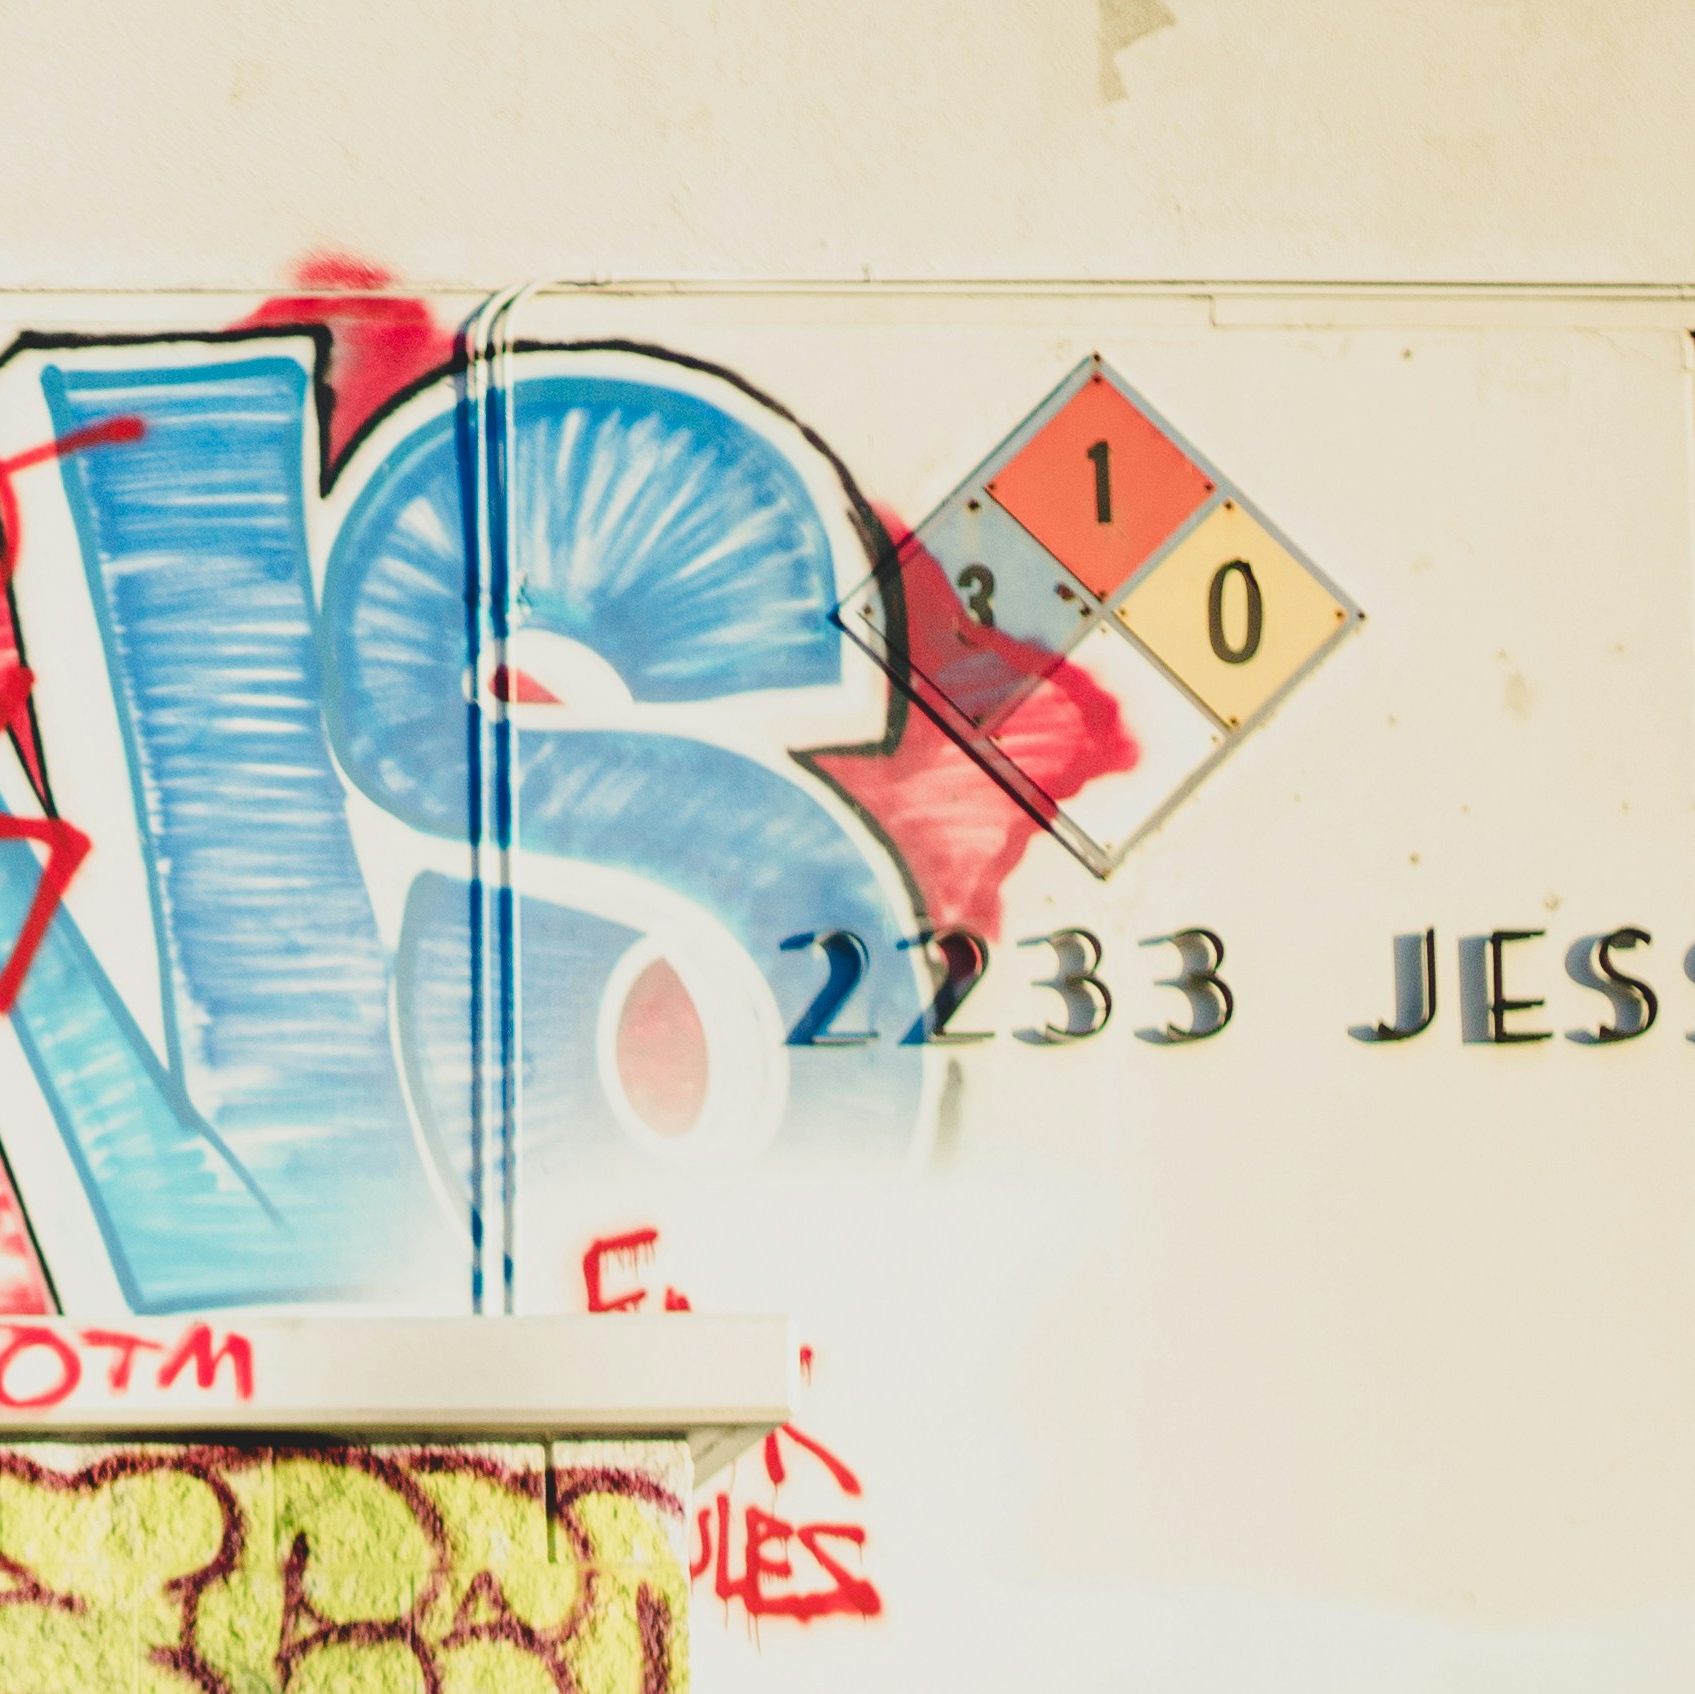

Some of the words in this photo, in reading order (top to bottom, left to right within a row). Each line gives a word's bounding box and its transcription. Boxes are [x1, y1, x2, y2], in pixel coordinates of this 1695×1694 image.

[1085, 439, 1114, 525] 1
[955, 562, 997, 648] 3
[1207, 559, 1264, 666] 0
[778, 927, 1235, 1047] 2233
[1347, 926, 1695, 1045] JES
